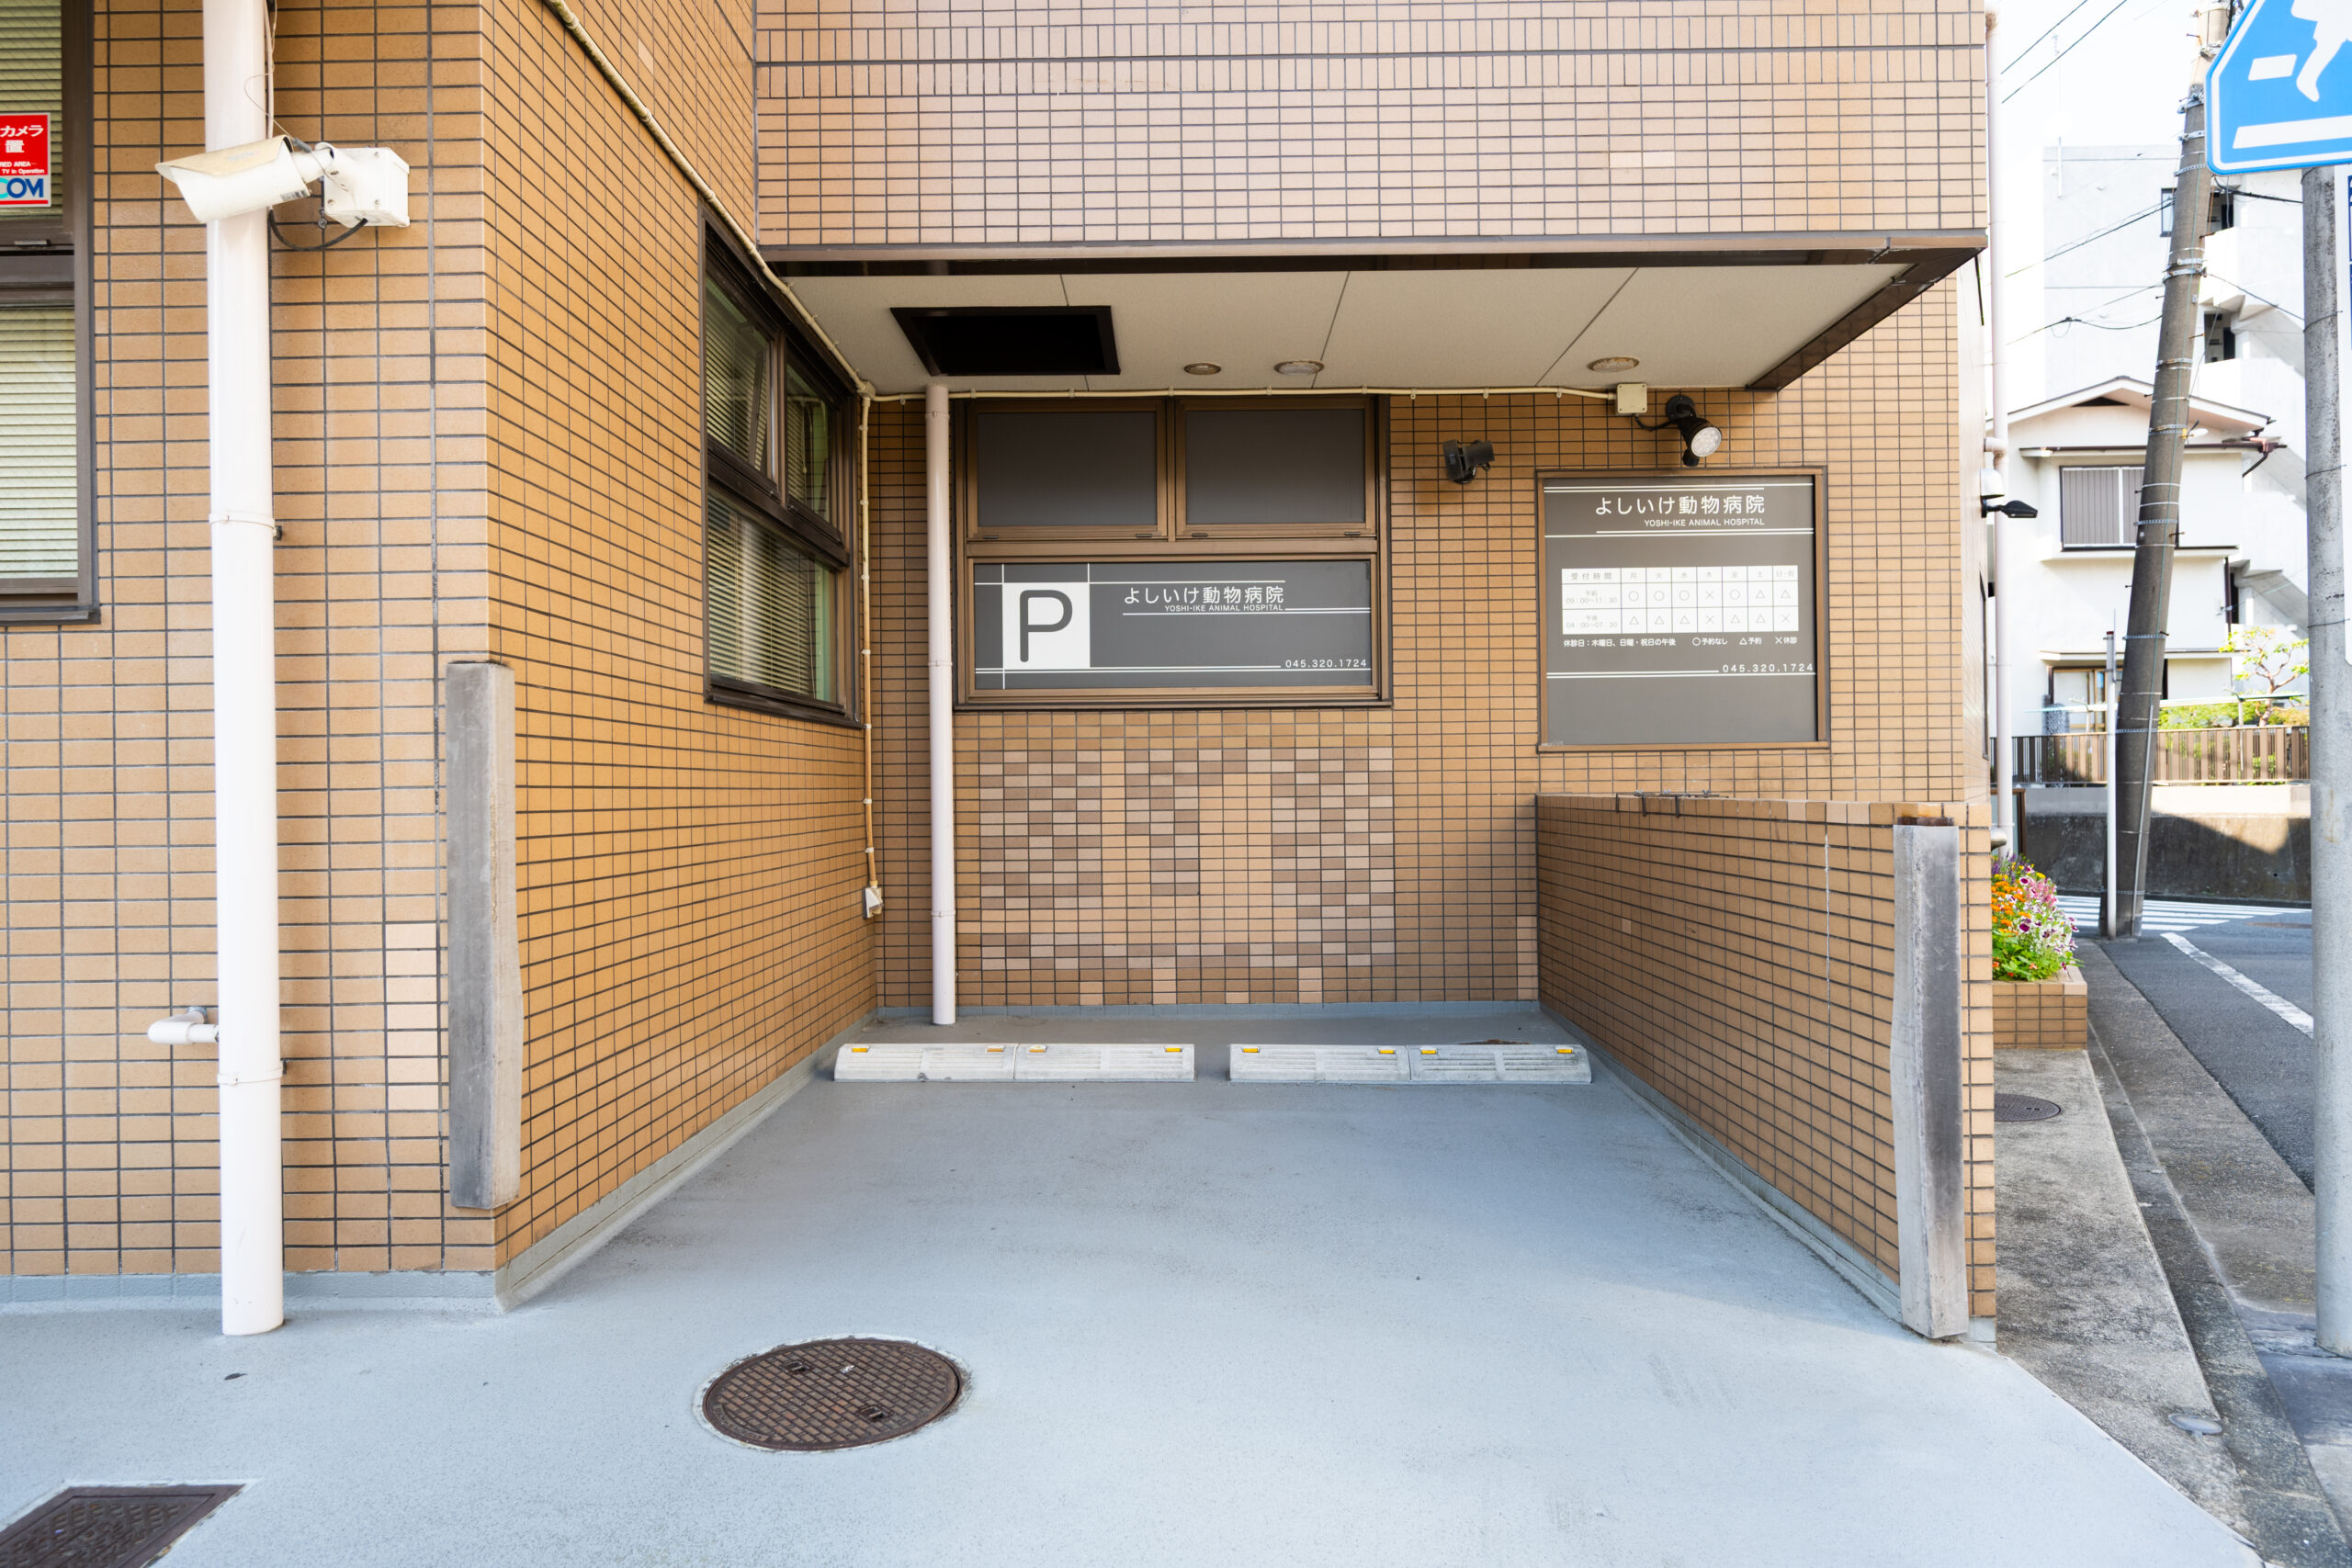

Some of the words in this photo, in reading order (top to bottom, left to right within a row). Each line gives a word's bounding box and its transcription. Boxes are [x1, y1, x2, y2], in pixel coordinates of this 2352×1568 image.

[6, 140, 25, 153] 置
[1595, 494, 1765, 515] よしいけ動物病院
[1645, 519, 1686, 527] YOSHI-IKE
[1689, 518, 1722, 526] ANIMAL
[1724, 517, 1765, 525] HOSPITAL
[1124, 586, 1283, 604] よしいけ動物病院
[1243, 604, 1283, 612] HOSPITAL
[1020, 590, 1073, 662] P
[1285, 659, 1367, 669] 045.320.1724
[1723, 663, 1814, 672] 045.320.1724
